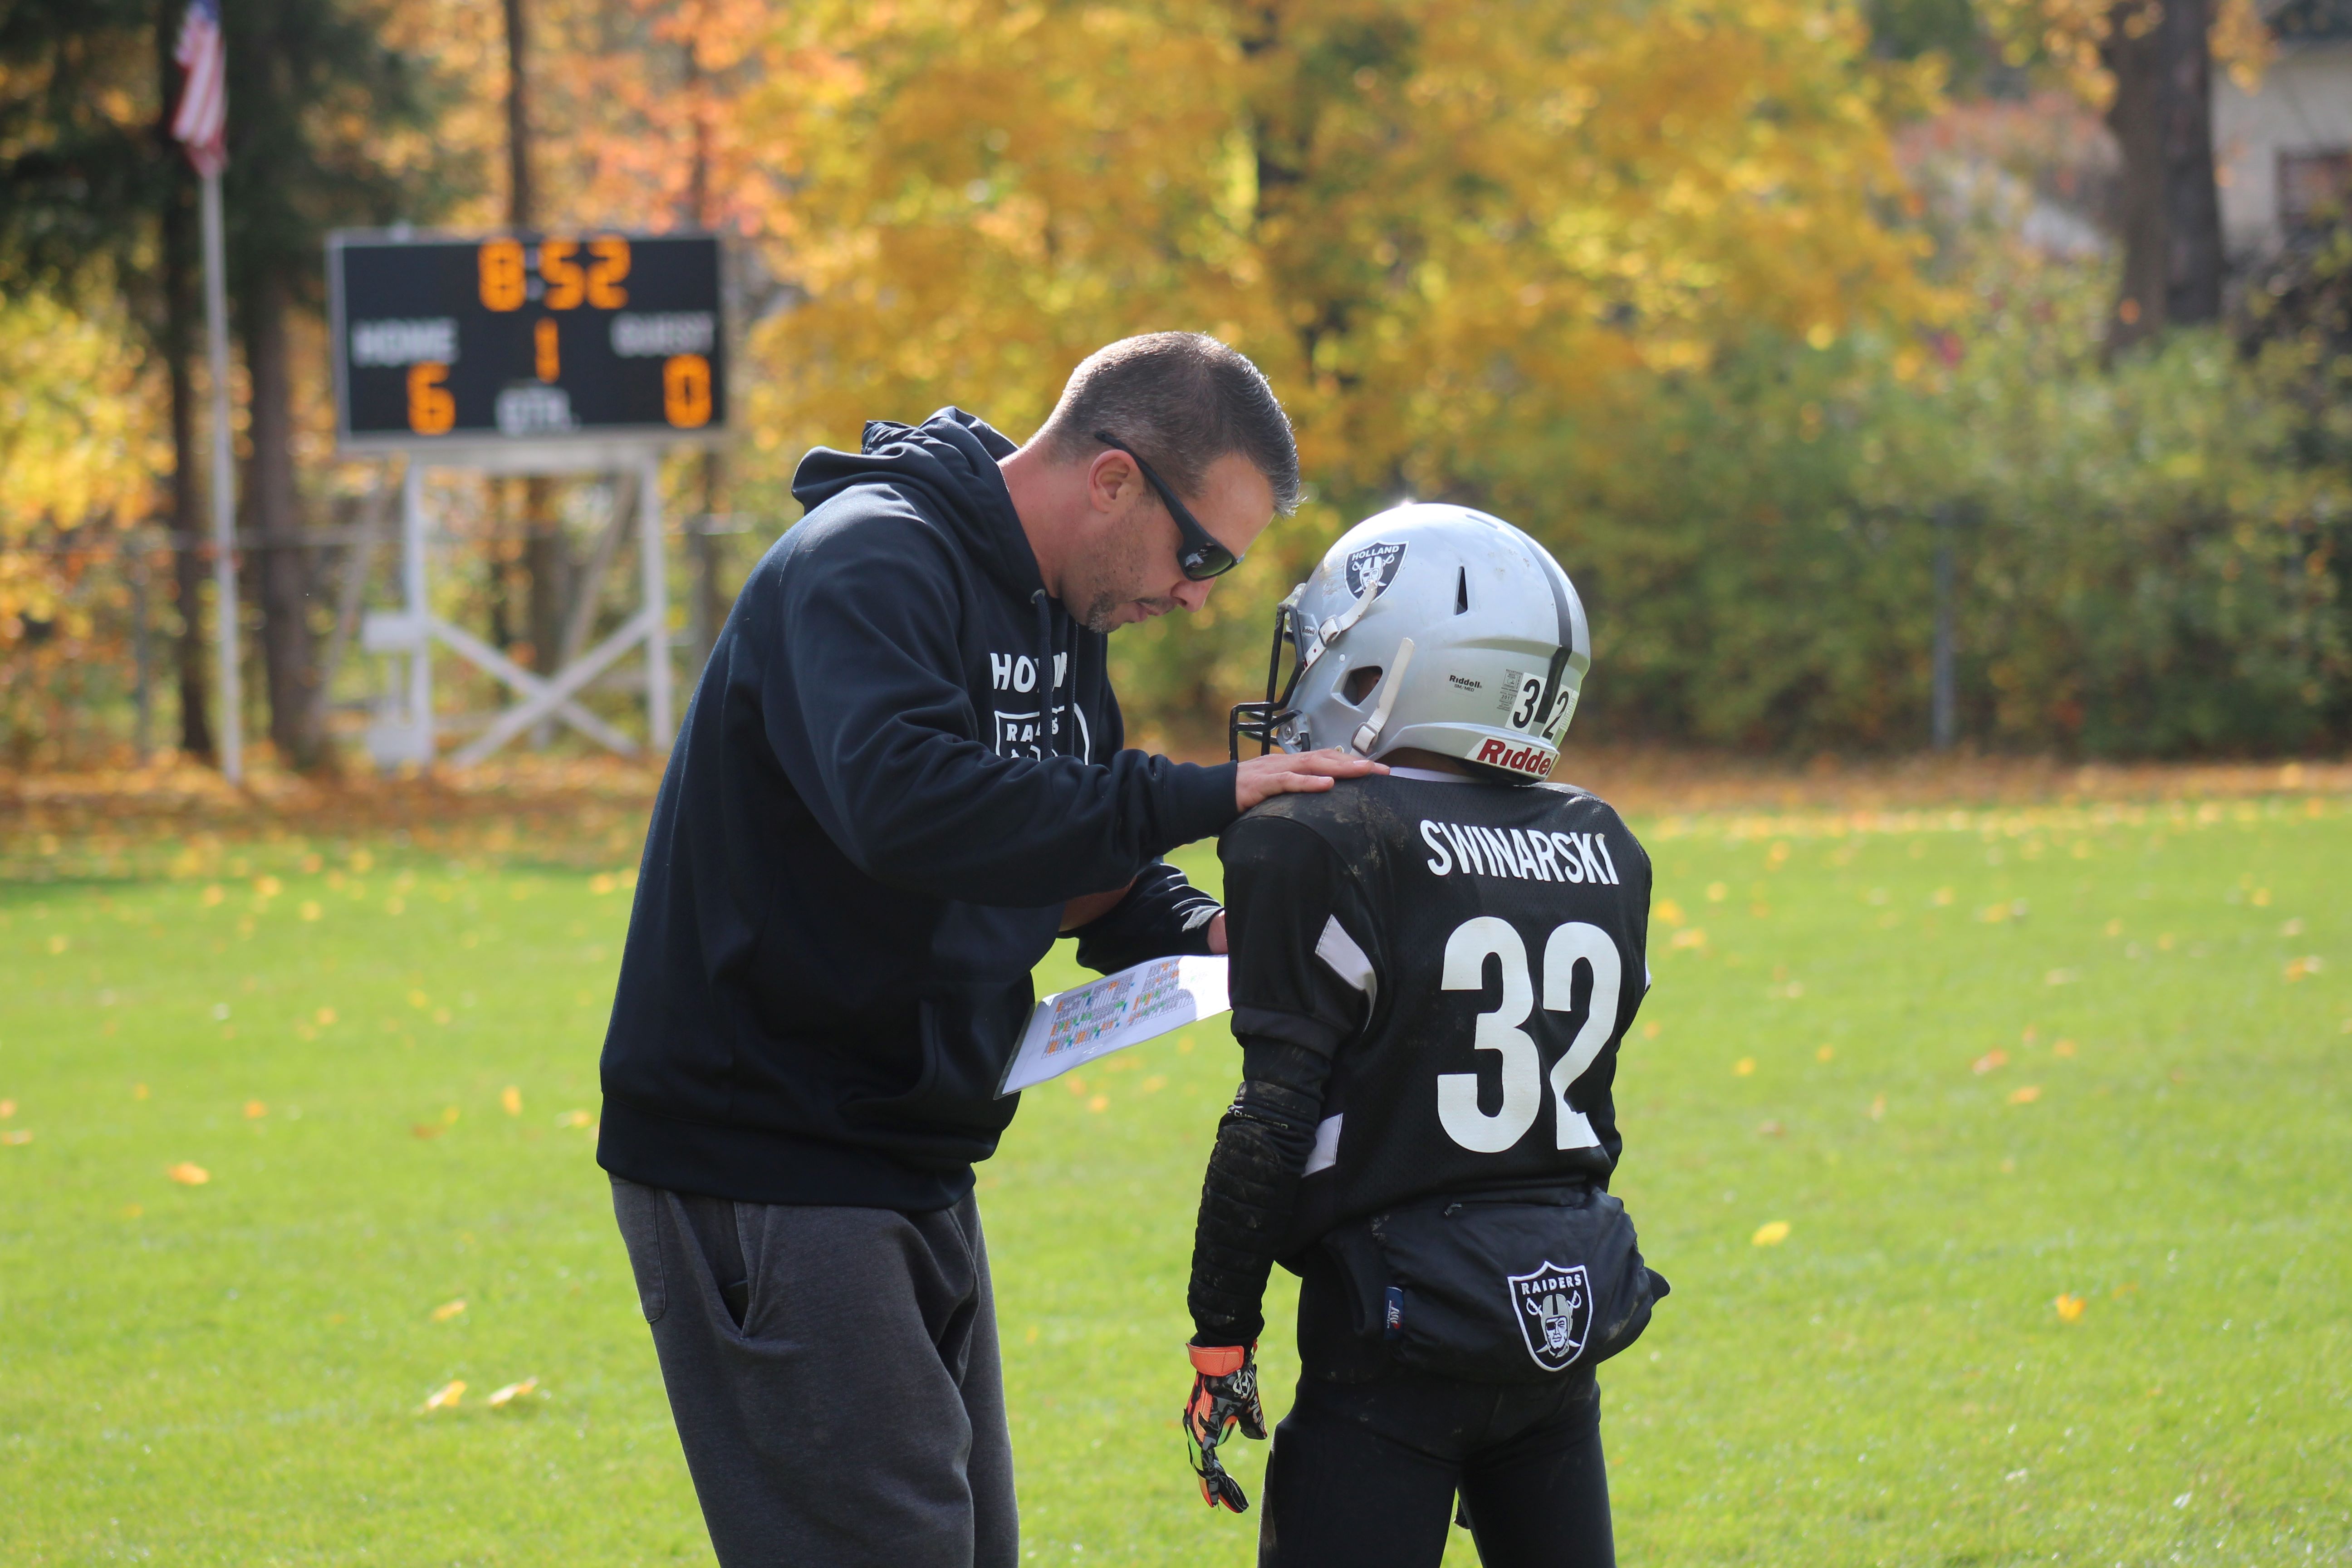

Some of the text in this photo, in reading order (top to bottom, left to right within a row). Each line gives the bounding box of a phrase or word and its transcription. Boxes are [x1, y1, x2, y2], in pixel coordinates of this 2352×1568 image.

[477, 235, 631, 312] 8:52
[534, 317, 560, 384] 1
[407, 360, 456, 436] 6
[663, 353, 712, 429] 0
[1352, 546, 1399, 561] HOLLAND
[1454, 684, 1474, 692] SM/MED
[1420, 820, 1620, 885] SWINARSKI
[1437, 916, 1622, 1153] 32
[1521, 1274, 1582, 1295] RAIDERS
